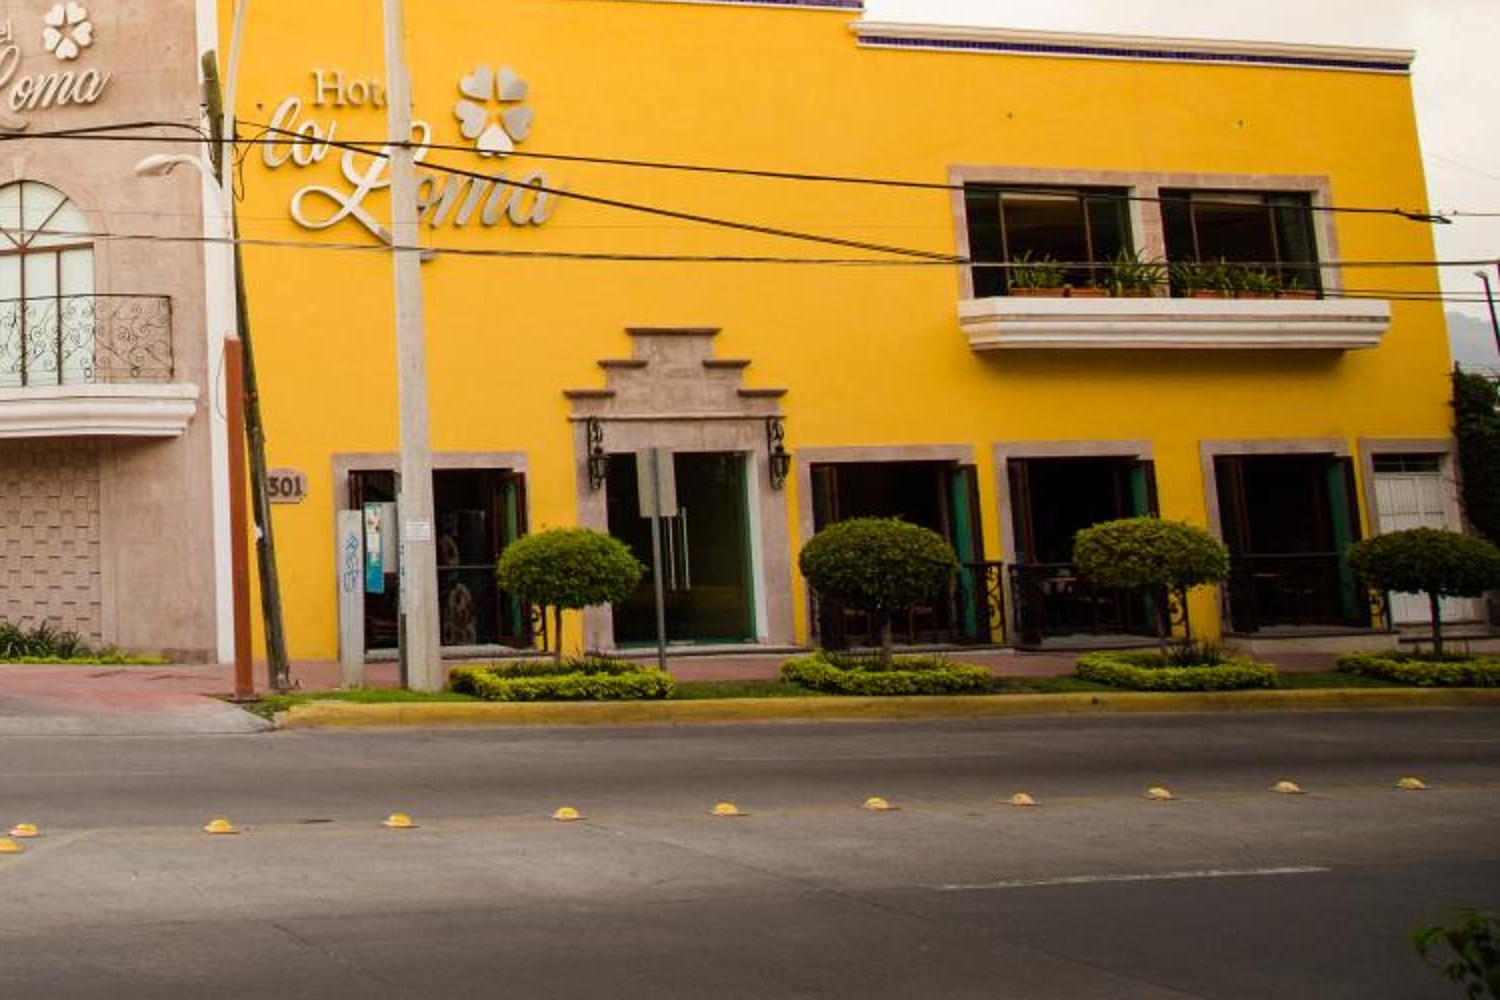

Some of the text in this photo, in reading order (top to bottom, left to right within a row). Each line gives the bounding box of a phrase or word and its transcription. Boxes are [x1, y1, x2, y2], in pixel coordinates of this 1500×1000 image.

[311, 69, 415, 106] Hot
[261, 95, 337, 169] la
[267, 475, 302, 497] 301
